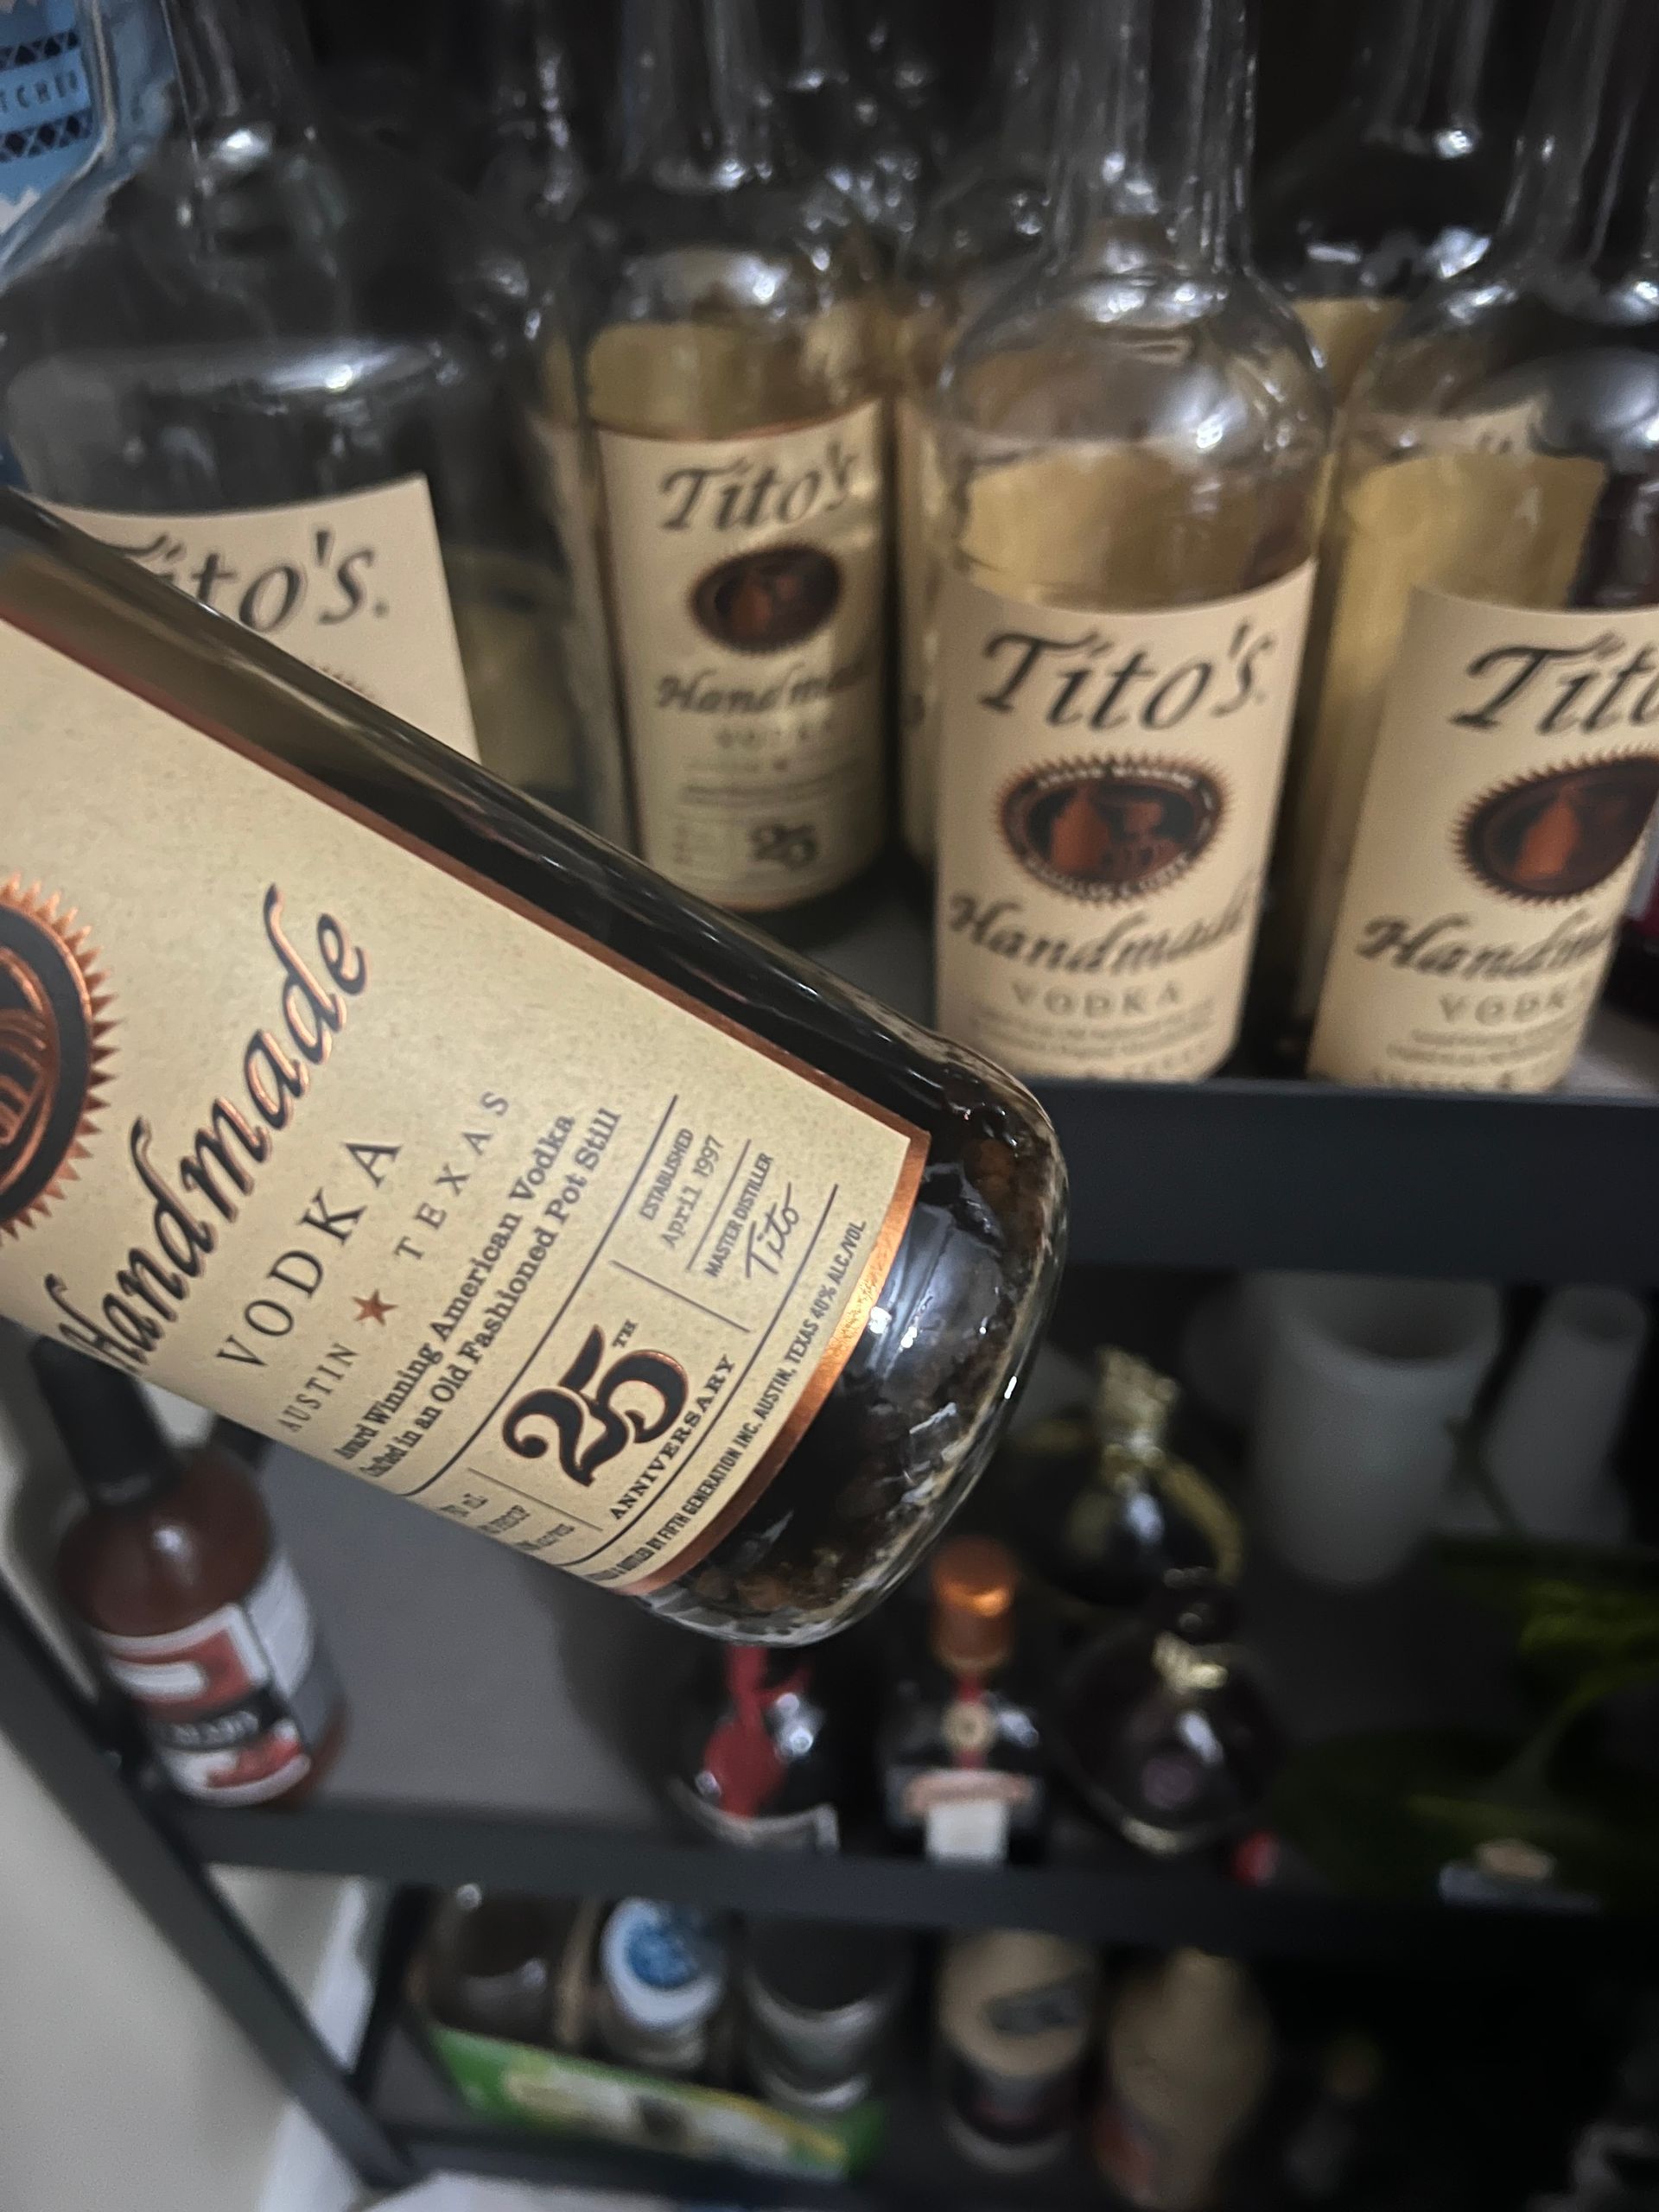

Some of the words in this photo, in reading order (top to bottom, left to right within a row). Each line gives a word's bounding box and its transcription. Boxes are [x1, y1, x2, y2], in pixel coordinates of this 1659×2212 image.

[658, 439, 858, 531] Tito's
[1011, 980, 1182, 1018] VODKA
[43, 881, 370, 1376] Handmade
[639, 1127, 695, 1221] ESTABLISHED
[660, 1185, 703, 1249] April
[691, 1133, 725, 1179] 1997
[216, 1141, 404, 1368] VODKA
[276, 1341, 359, 1433] AUSTIN
[392, 1091, 510, 1262] TEXAS
[361, 1341, 444, 1426] Winning
[429, 1212, 524, 1344] American
[507, 1114, 576, 1202] Vodka
[412, 1405, 443, 1432] an
[429, 1363, 474, 1403] Old
[455, 1224, 559, 1366] Fashioned
[543, 1173, 588, 1226] Pot
[574, 1107, 621, 1173] Still
[703, 1219, 745, 1278] MASTER
[732, 1151, 774, 1222] DISTILLER
[746, 1180, 800, 1278] Tito
[502, 1324, 690, 1488] 25
[612, 1319, 638, 1349] TH
[608, 1352, 736, 1521] ANNIVERSARY
[656, 1512, 692, 1542] FIFTH
[680, 1446, 744, 1516] GENERATION
[731, 1421, 764, 1451] INC.
[753, 1368, 798, 1422] AUSTIN,
[783, 1319, 820, 1365] TEXAS
[810, 1284, 838, 1320] 40%
